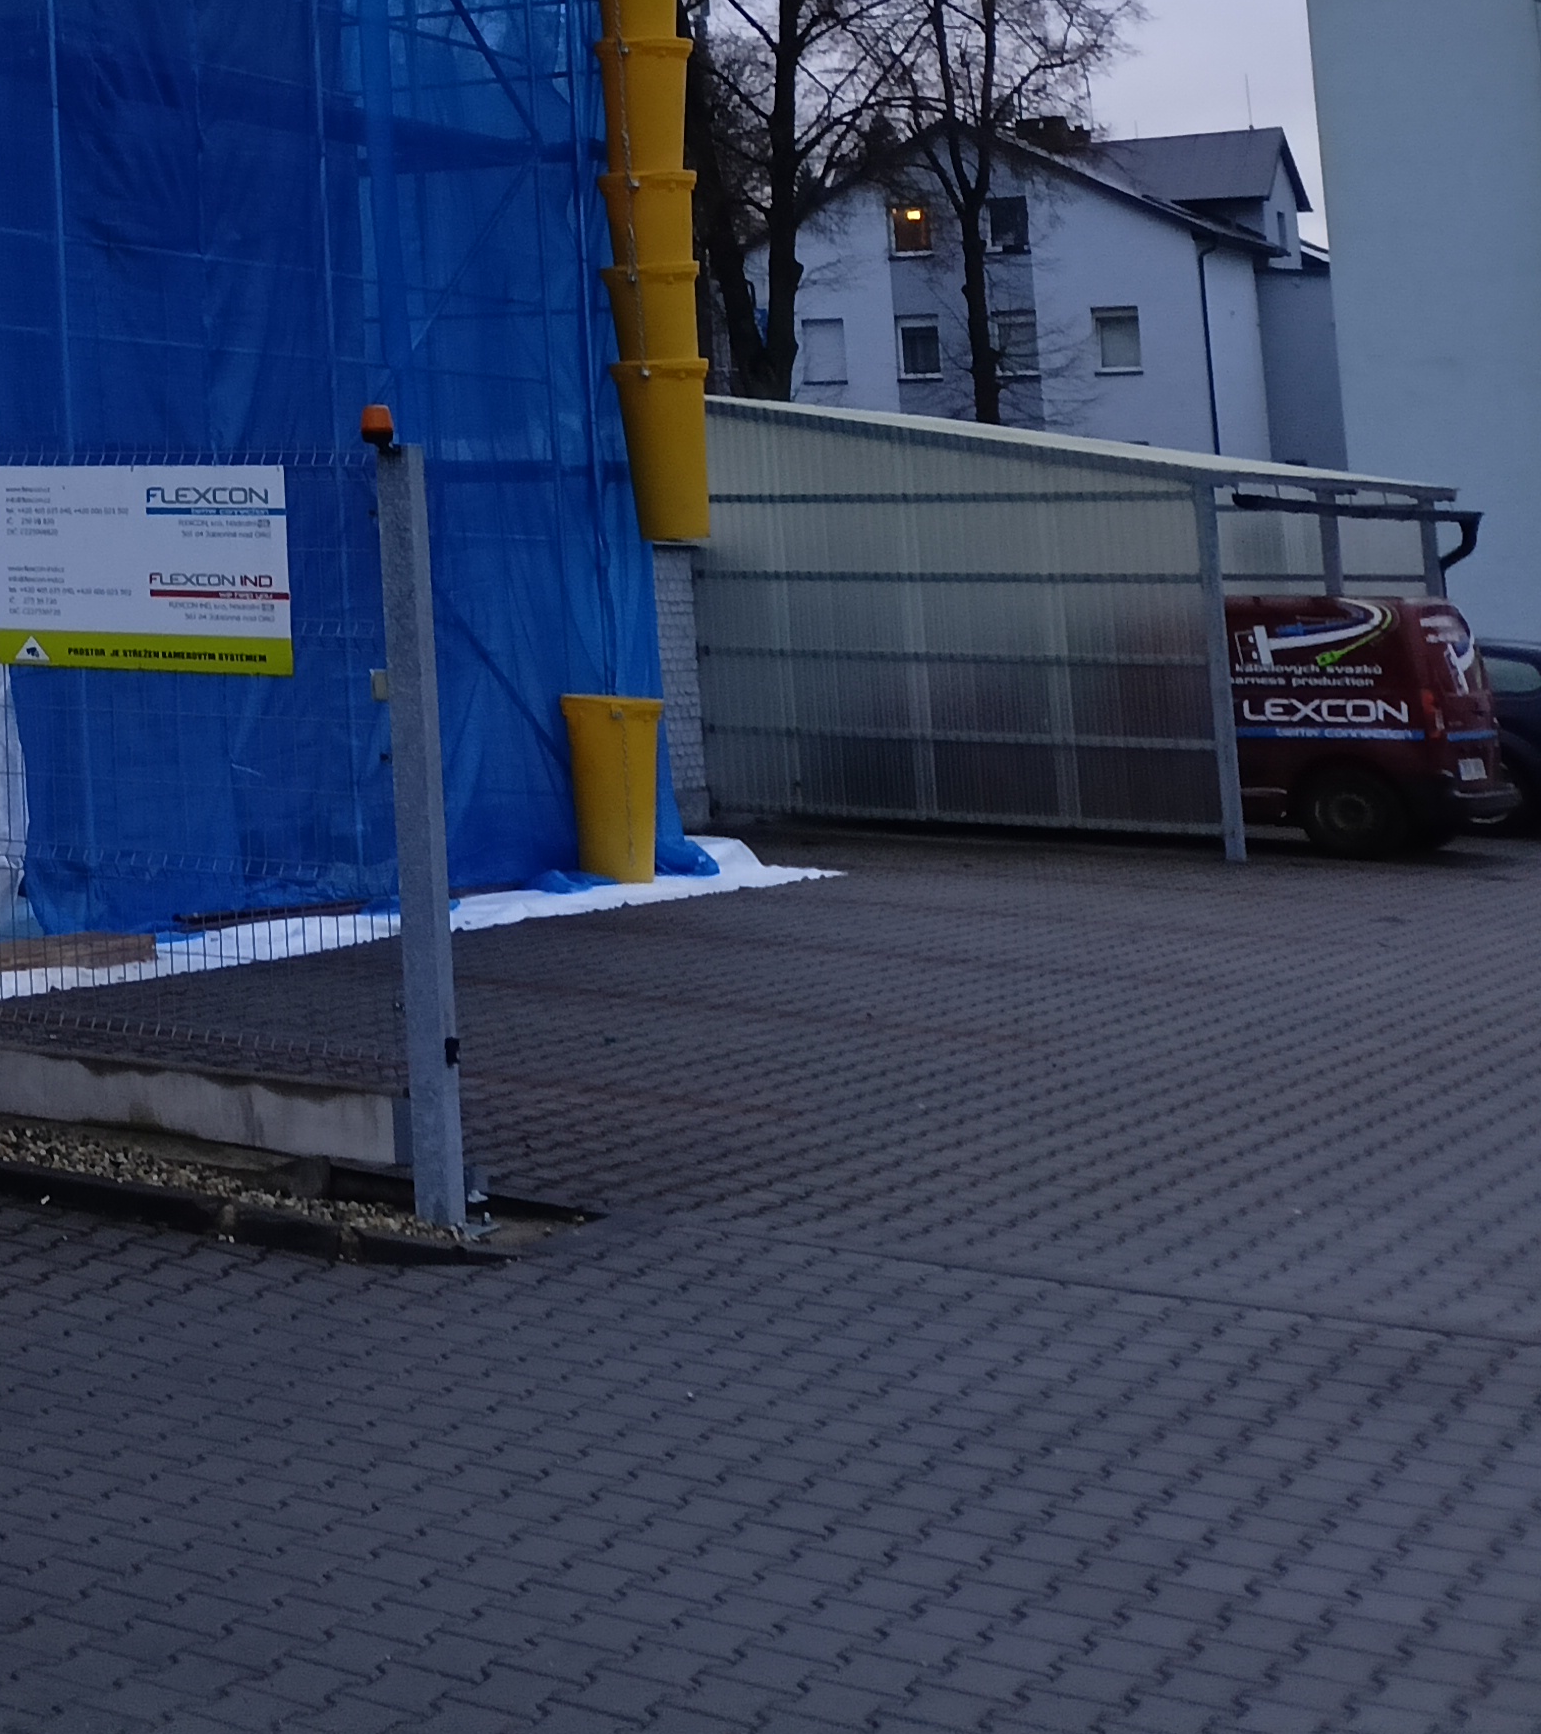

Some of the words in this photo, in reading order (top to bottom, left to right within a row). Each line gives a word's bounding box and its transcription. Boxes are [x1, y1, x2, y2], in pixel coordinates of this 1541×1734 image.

[146, 487, 269, 505] FLEXCON
[149, 572, 236, 586] FLEXCON
[240, 574, 273, 587] IND
[68, 646, 106, 657] PROSTOR
[110, 649, 119, 657] JE
[1292, 675, 1374, 688] production
[1242, 698, 1410, 723] LEXCON
